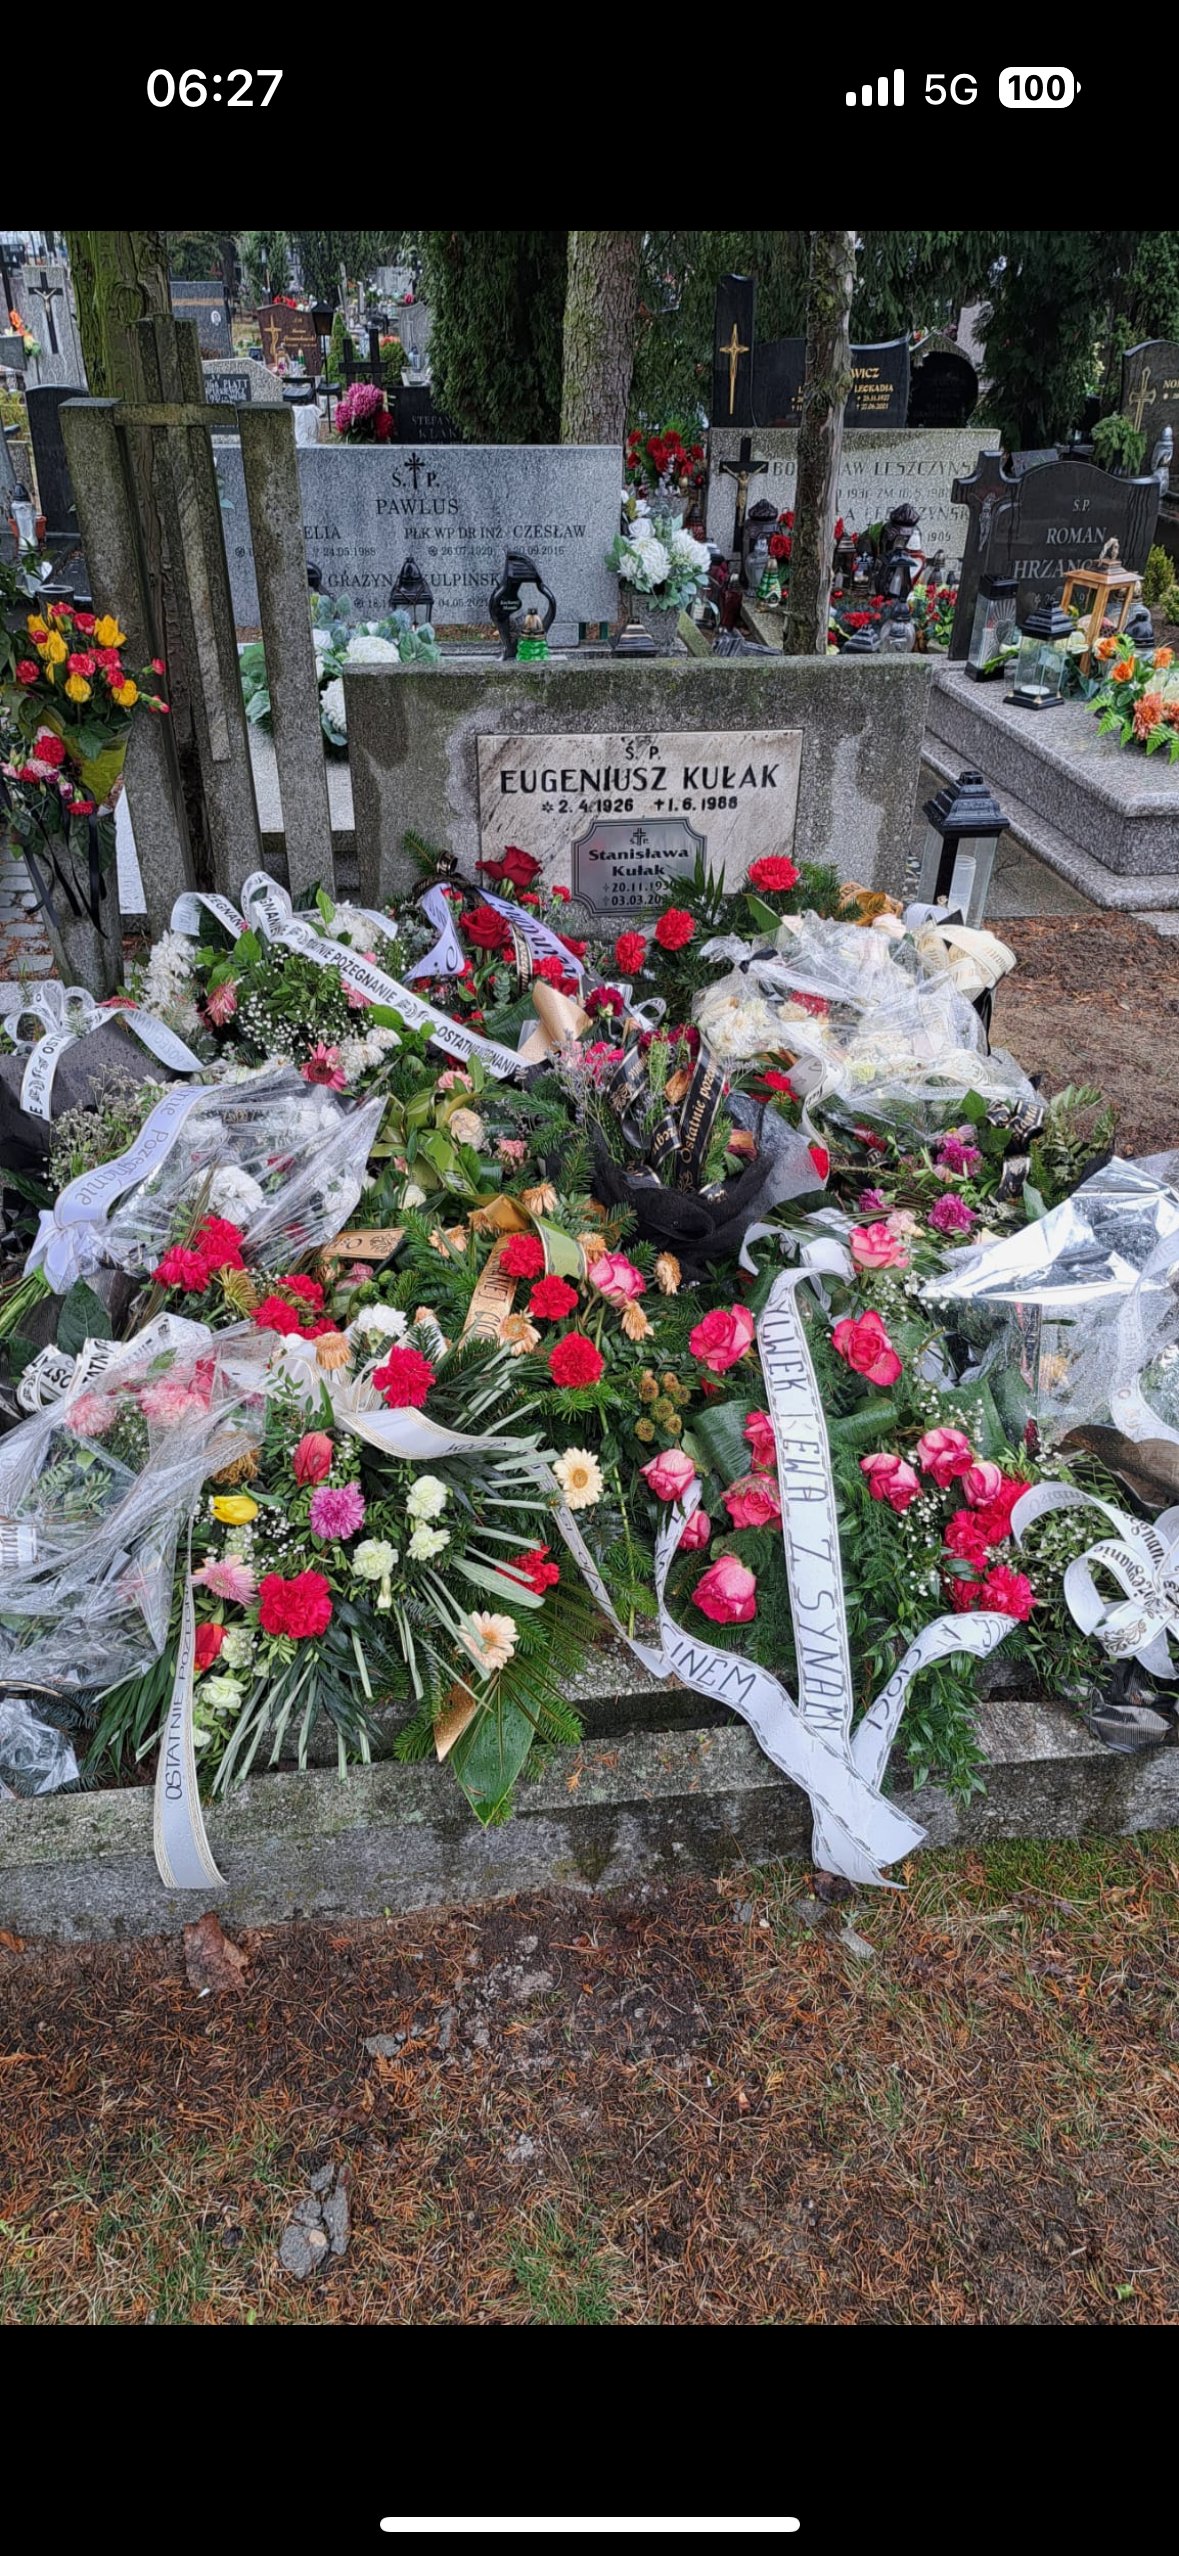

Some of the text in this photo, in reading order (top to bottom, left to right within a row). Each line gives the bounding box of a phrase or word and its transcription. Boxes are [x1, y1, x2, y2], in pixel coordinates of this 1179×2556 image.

[1046, 527, 1107, 545] ROMAN
[500, 763, 780, 794] EUGENIUSZ KUŁAK
[588, 848, 689, 861] Stanisława
[612, 864, 665, 877] Kułak
[786, 1438, 829, 1501] EWA
[798, 1590, 843, 1733] SYNAM
